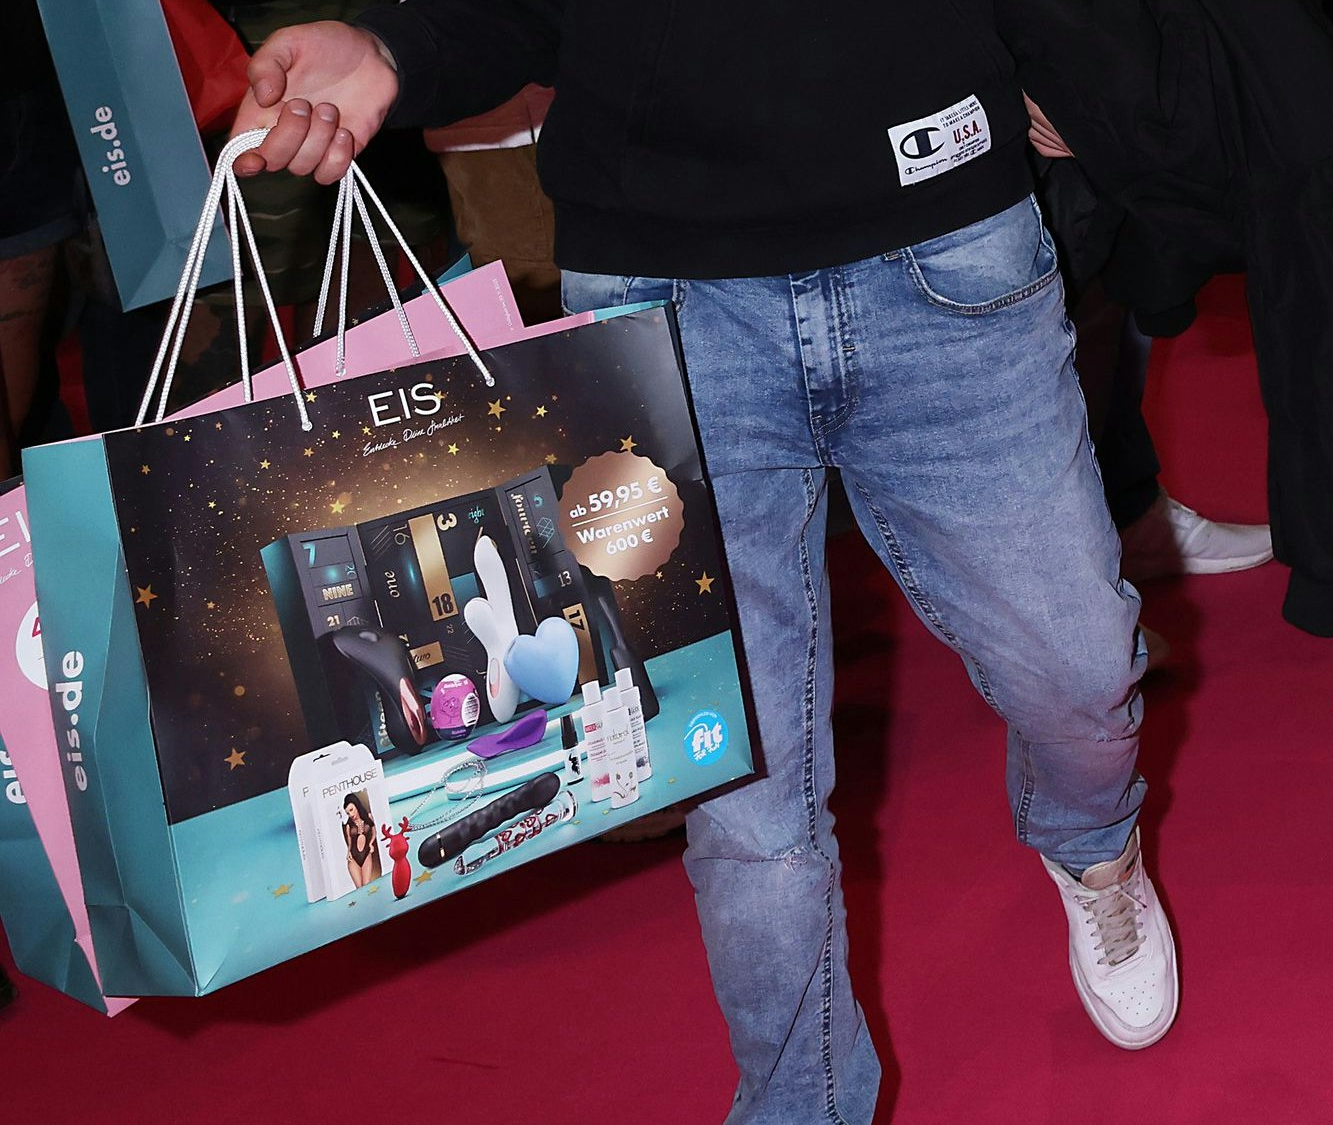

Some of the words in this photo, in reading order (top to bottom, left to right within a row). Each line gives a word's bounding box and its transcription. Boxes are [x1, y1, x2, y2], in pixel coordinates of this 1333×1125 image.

[953, 120, 982, 144] U.S.A.
[90, 105, 131, 187] eis.de
[904, 158, 948, 175] Champion
[368, 383, 441, 427] EIS
[569, 504, 587, 518] ab
[588, 482, 644, 512] 59,95
[647, 476, 662, 494] €
[436, 513, 458, 531] 3
[576, 506, 669, 544] Warenwert
[606, 534, 638, 555] 600
[641, 528, 654, 543] €
[303, 543, 316, 568] 7
[322, 583, 354, 601] NINE
[558, 571, 573, 588] 13
[432, 593, 454, 616] 18
[327, 615, 340, 626] 21
[55, 650, 88, 792] eis.de
[322, 768, 379, 800] PENTHOUSE
